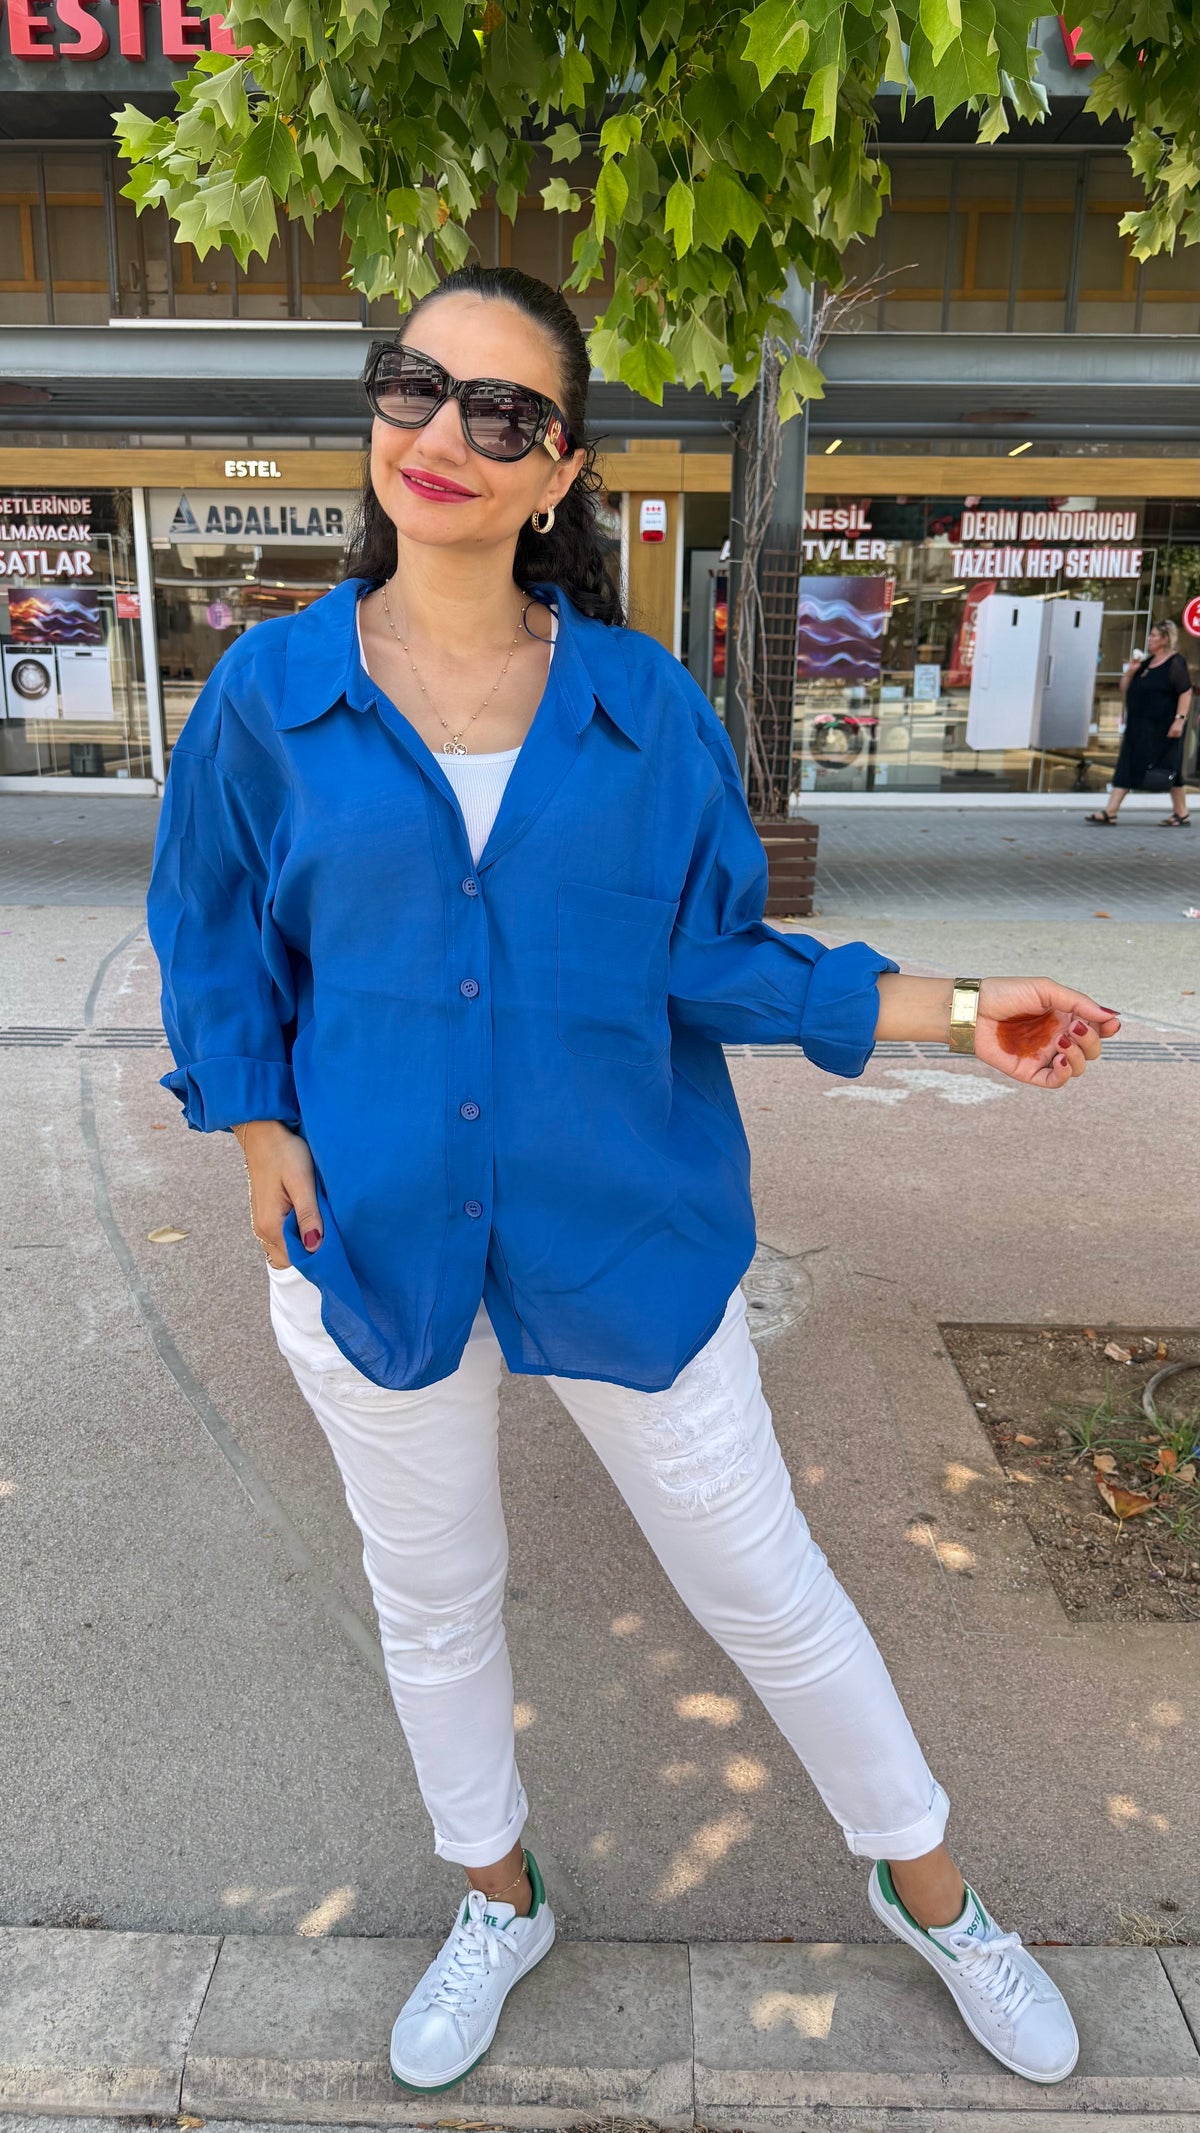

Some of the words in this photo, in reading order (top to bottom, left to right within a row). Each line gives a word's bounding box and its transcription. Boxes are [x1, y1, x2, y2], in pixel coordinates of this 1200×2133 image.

[225, 460, 281, 477] ESTEL
[205, 506, 343, 536] ADALILAR
[802, 504, 872, 530] NESİL
[962, 509, 1018, 541] DERİN
[1021, 512, 1137, 541] DONDURUCU
[953, 546, 1024, 578] TAZELİK
[1026, 549, 1064, 578] HEP
[1066, 546, 1142, 578] SENİNLE
